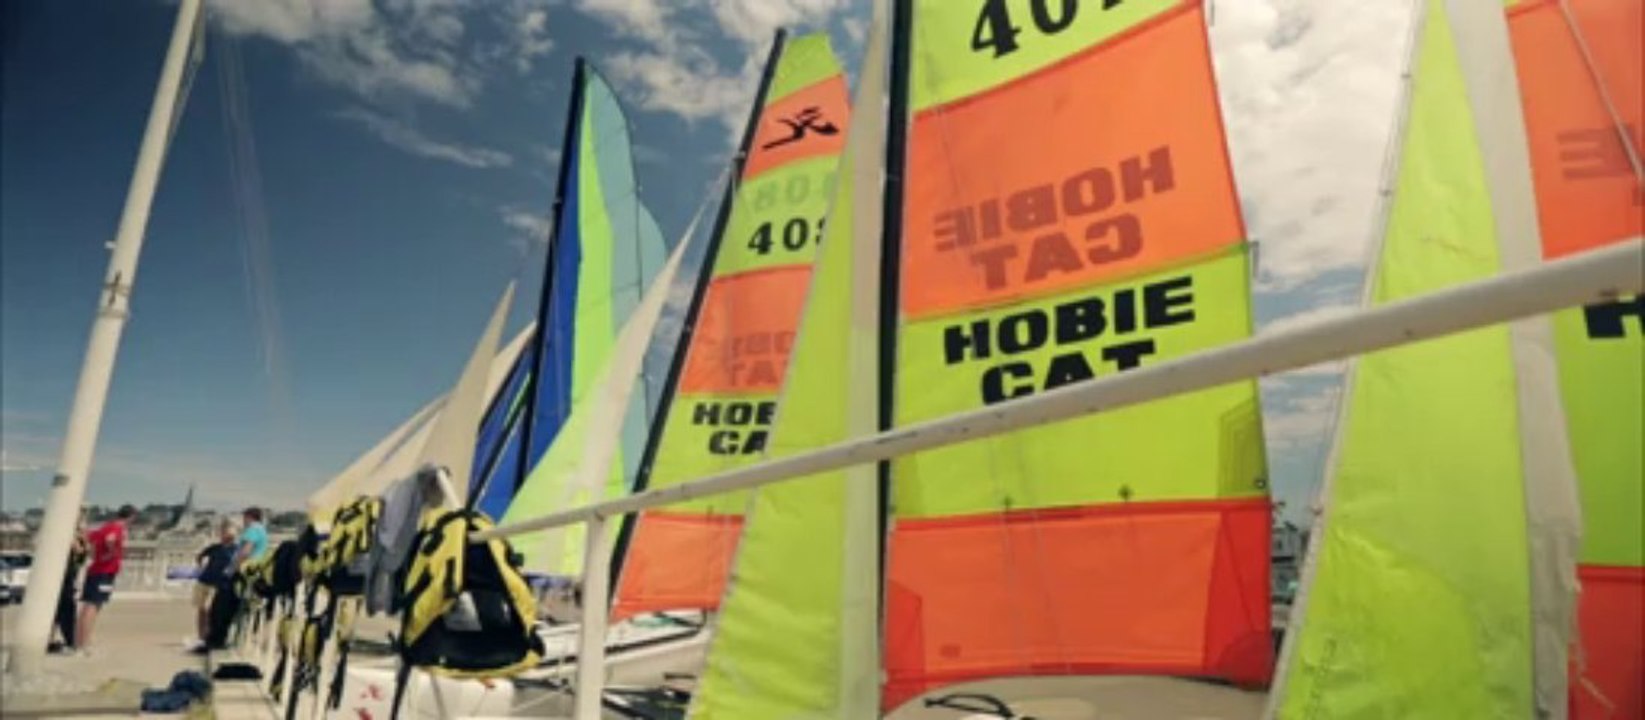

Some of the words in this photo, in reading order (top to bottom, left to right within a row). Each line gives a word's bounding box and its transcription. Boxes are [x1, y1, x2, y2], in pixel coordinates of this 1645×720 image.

[971, 0, 1124, 58] 40
[747, 218, 825, 255] 40
[944, 276, 1195, 364] HOBIE
[981, 339, 1155, 405] CAT
